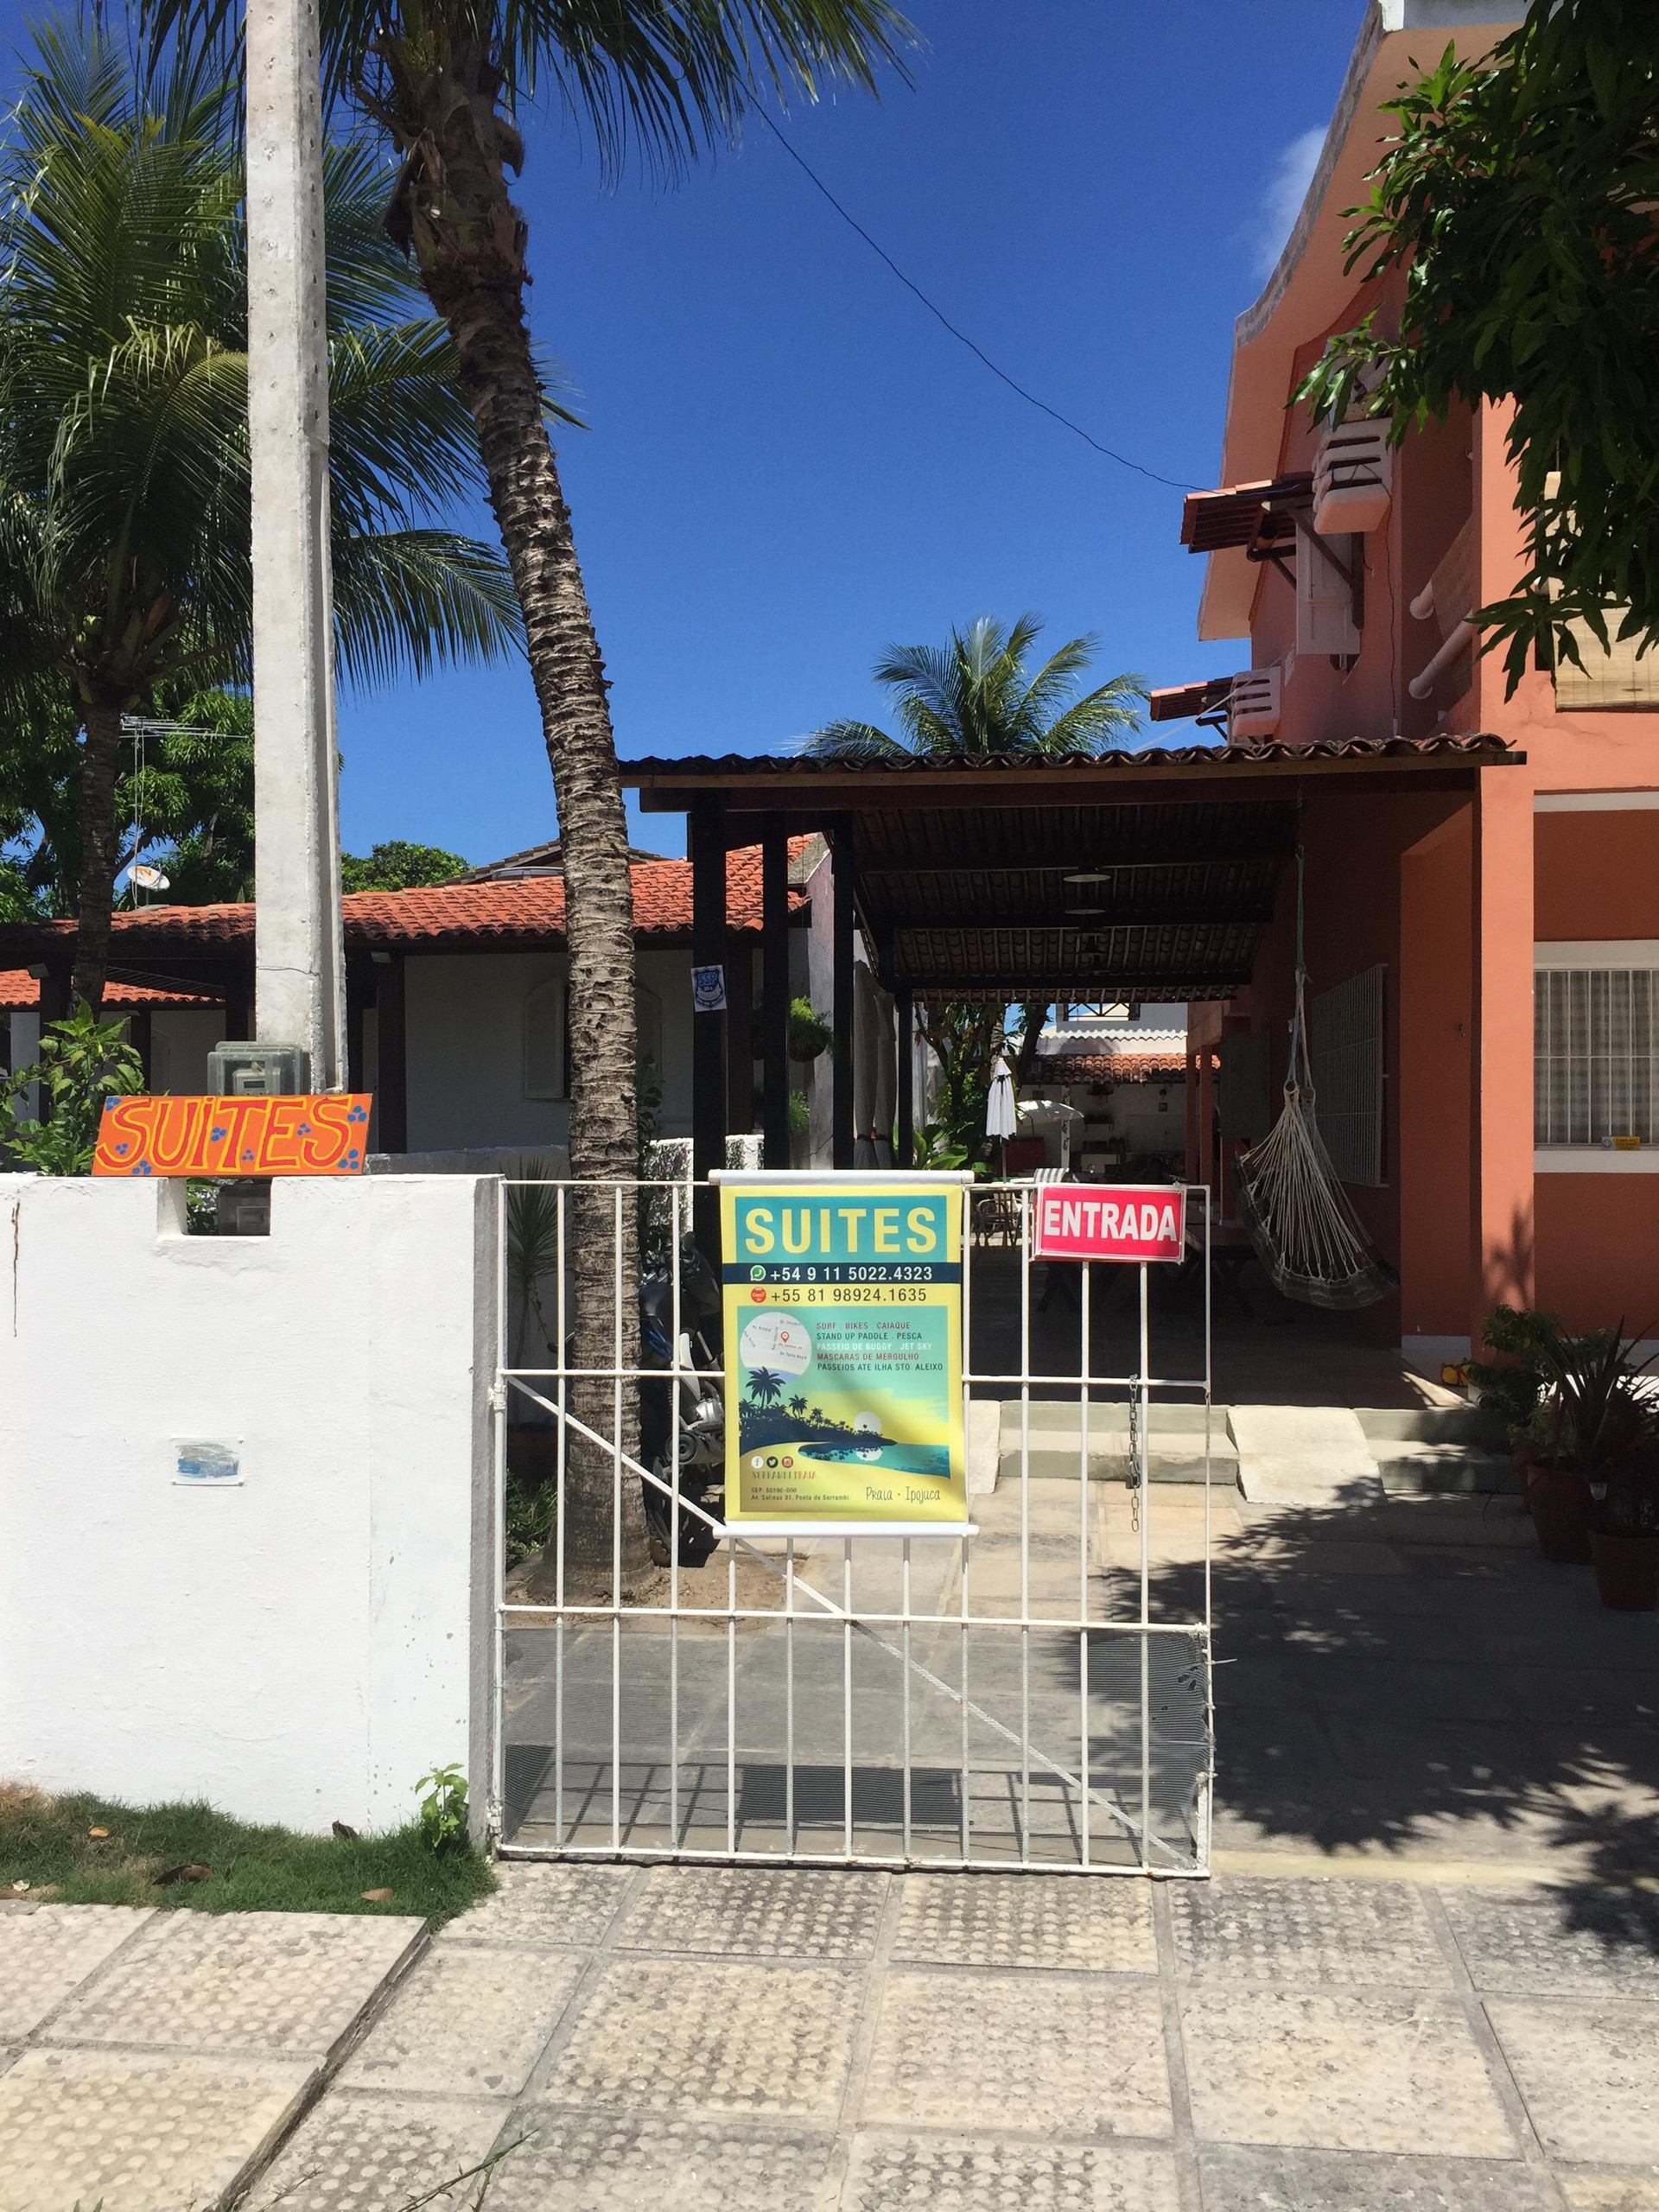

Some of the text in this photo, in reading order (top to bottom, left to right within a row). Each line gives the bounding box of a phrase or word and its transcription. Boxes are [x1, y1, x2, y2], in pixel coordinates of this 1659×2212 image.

[1044, 1199, 1178, 1242] ENTRADA
[745, 1207, 937, 1254] SUITES
[770, 1266, 933, 1281] +54 9 11 5022.4323
[771, 1288, 800, 1302] +55
[807, 1288, 825, 1302] 81
[833, 1287, 927, 1302] 98924.1635
[866, 1486, 940, 1503] Praia Ipojuca
